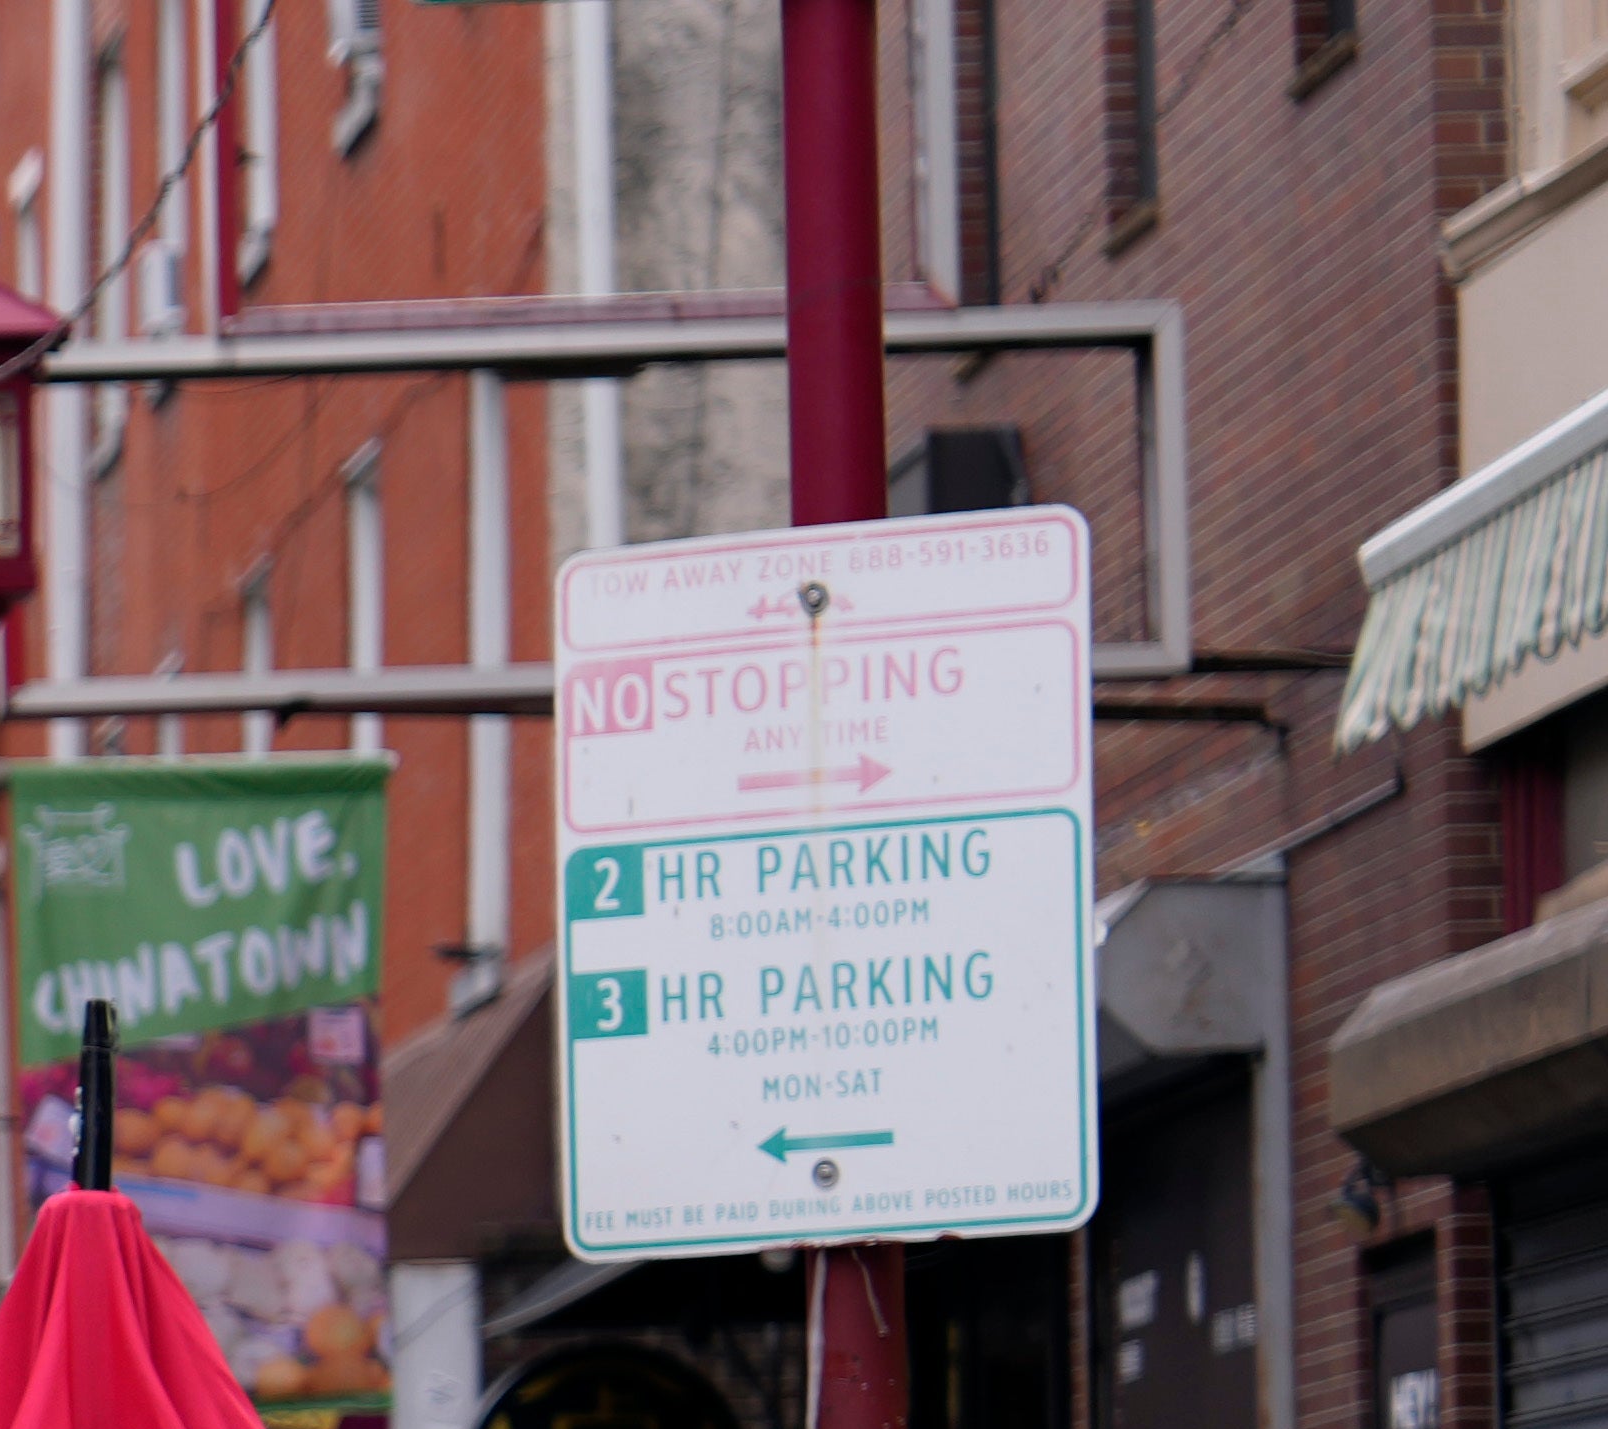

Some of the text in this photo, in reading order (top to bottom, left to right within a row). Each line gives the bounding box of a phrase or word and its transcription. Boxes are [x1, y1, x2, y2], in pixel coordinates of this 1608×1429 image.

[590, 529, 1052, 597] TOW AWAY ZONE 888-591-3636
[572, 645, 965, 733] NO STOPPING
[744, 715, 890, 754] ANY TIME
[592, 827, 993, 911] 2 HR PARKING
[709, 898, 931, 941] 8:00AM-4:00PM
[32, 900, 371, 1035] CHINATOWN
[596, 950, 996, 1032] 3 HR PARKING
[707, 1016, 940, 1057] 4:00PM-10:00PM
[762, 1068, 883, 1102] MON-SAT
[584, 1179, 1074, 1232] FEE MUST BE PAID DURING ABOVE POSTED HOURS
